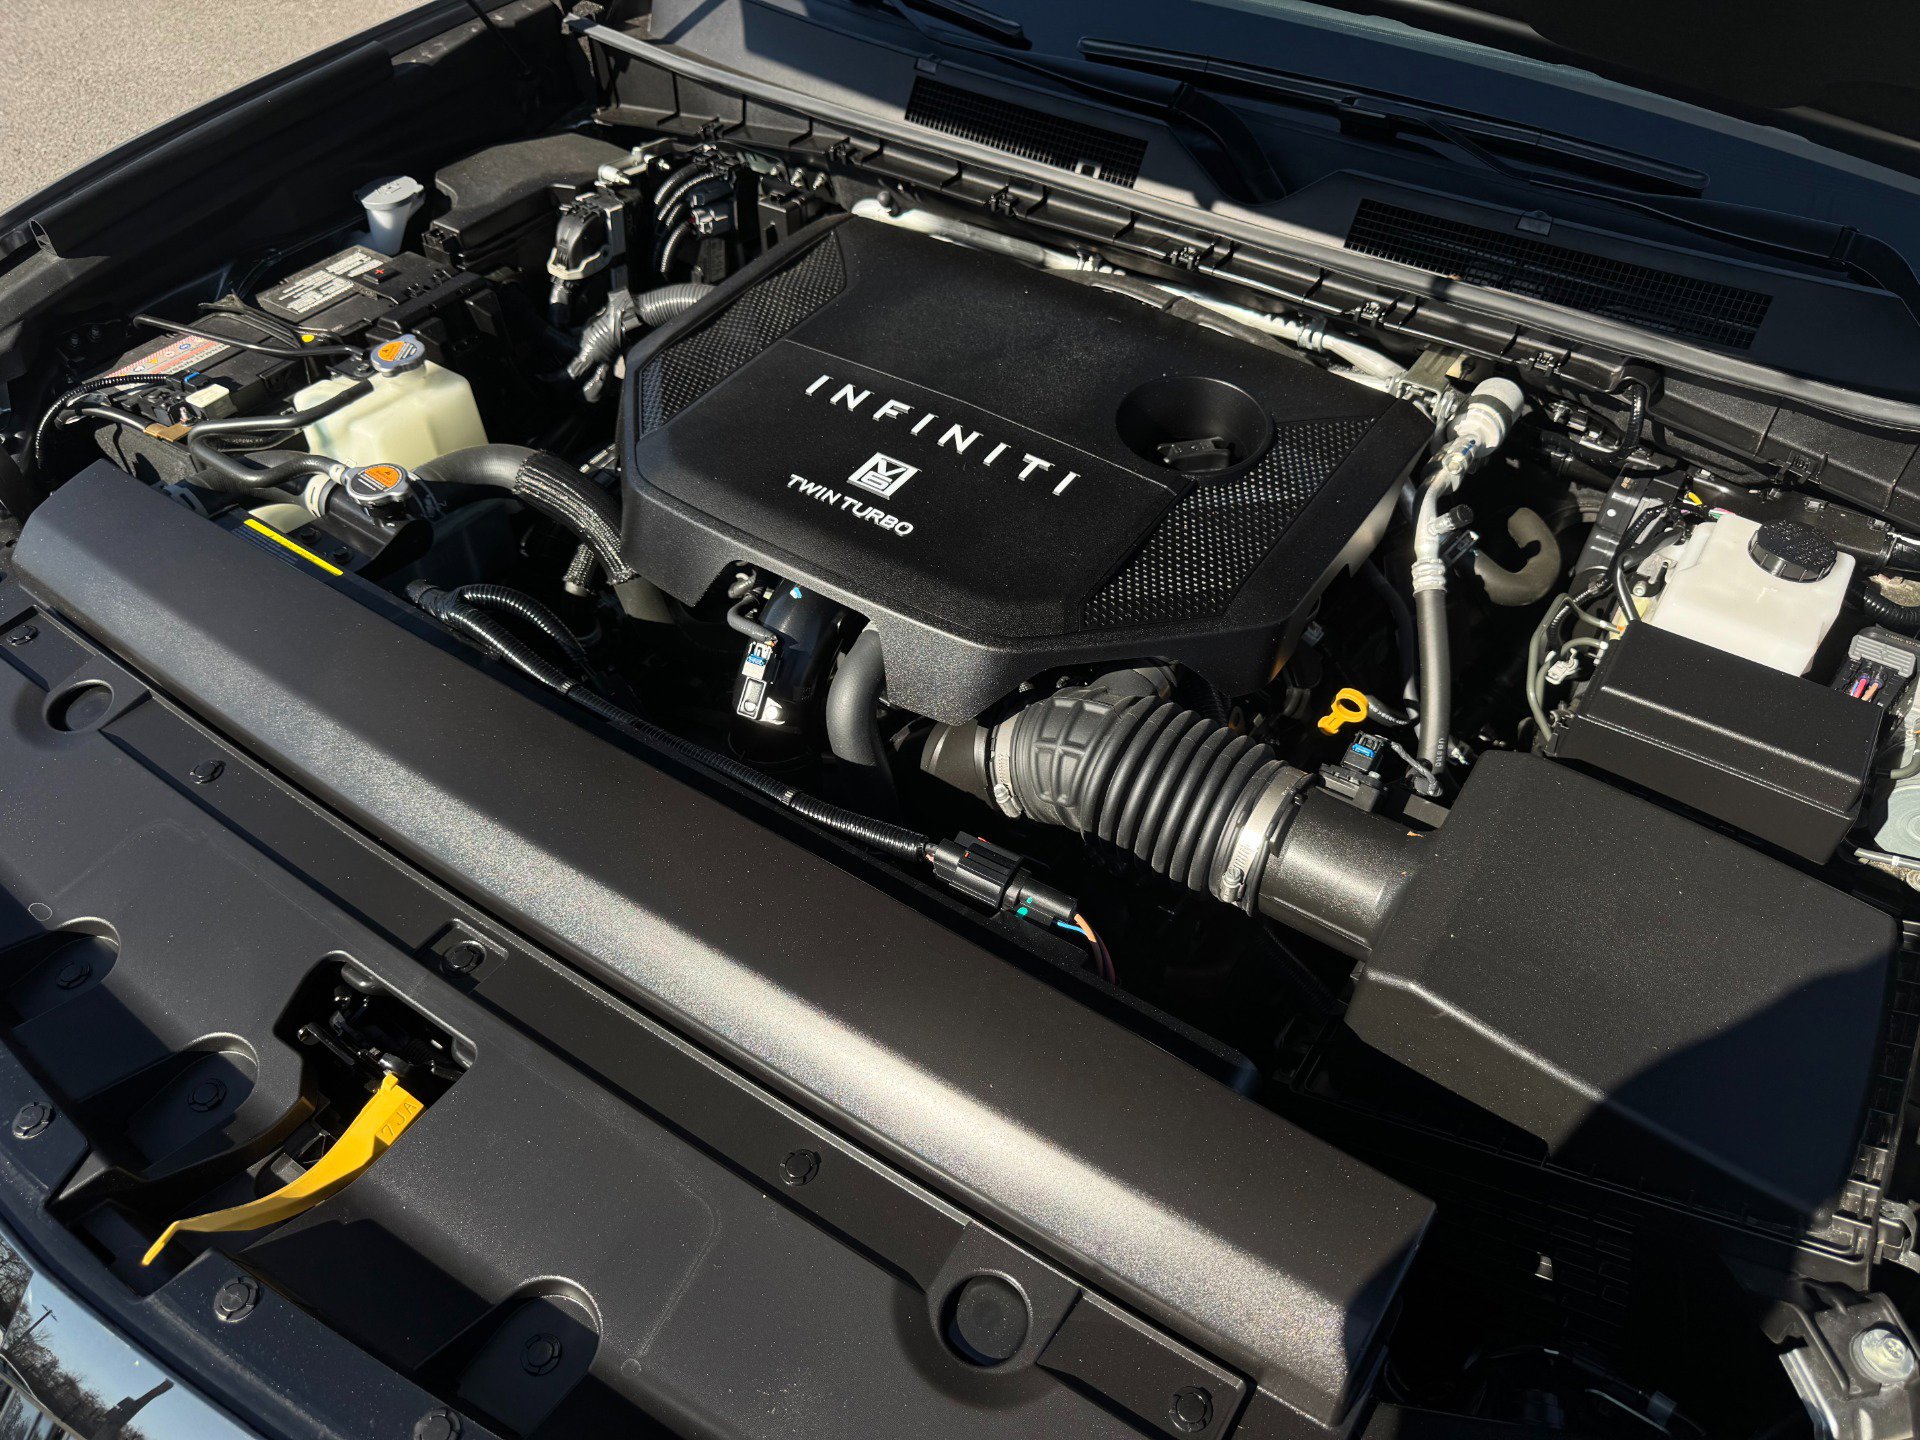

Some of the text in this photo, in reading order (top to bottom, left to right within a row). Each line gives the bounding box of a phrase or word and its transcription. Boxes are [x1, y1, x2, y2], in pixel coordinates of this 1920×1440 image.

[805, 374, 1081, 496] INFINITI
[787, 473, 914, 537] TWIN TURBO
[857, 456, 911, 494] V6
